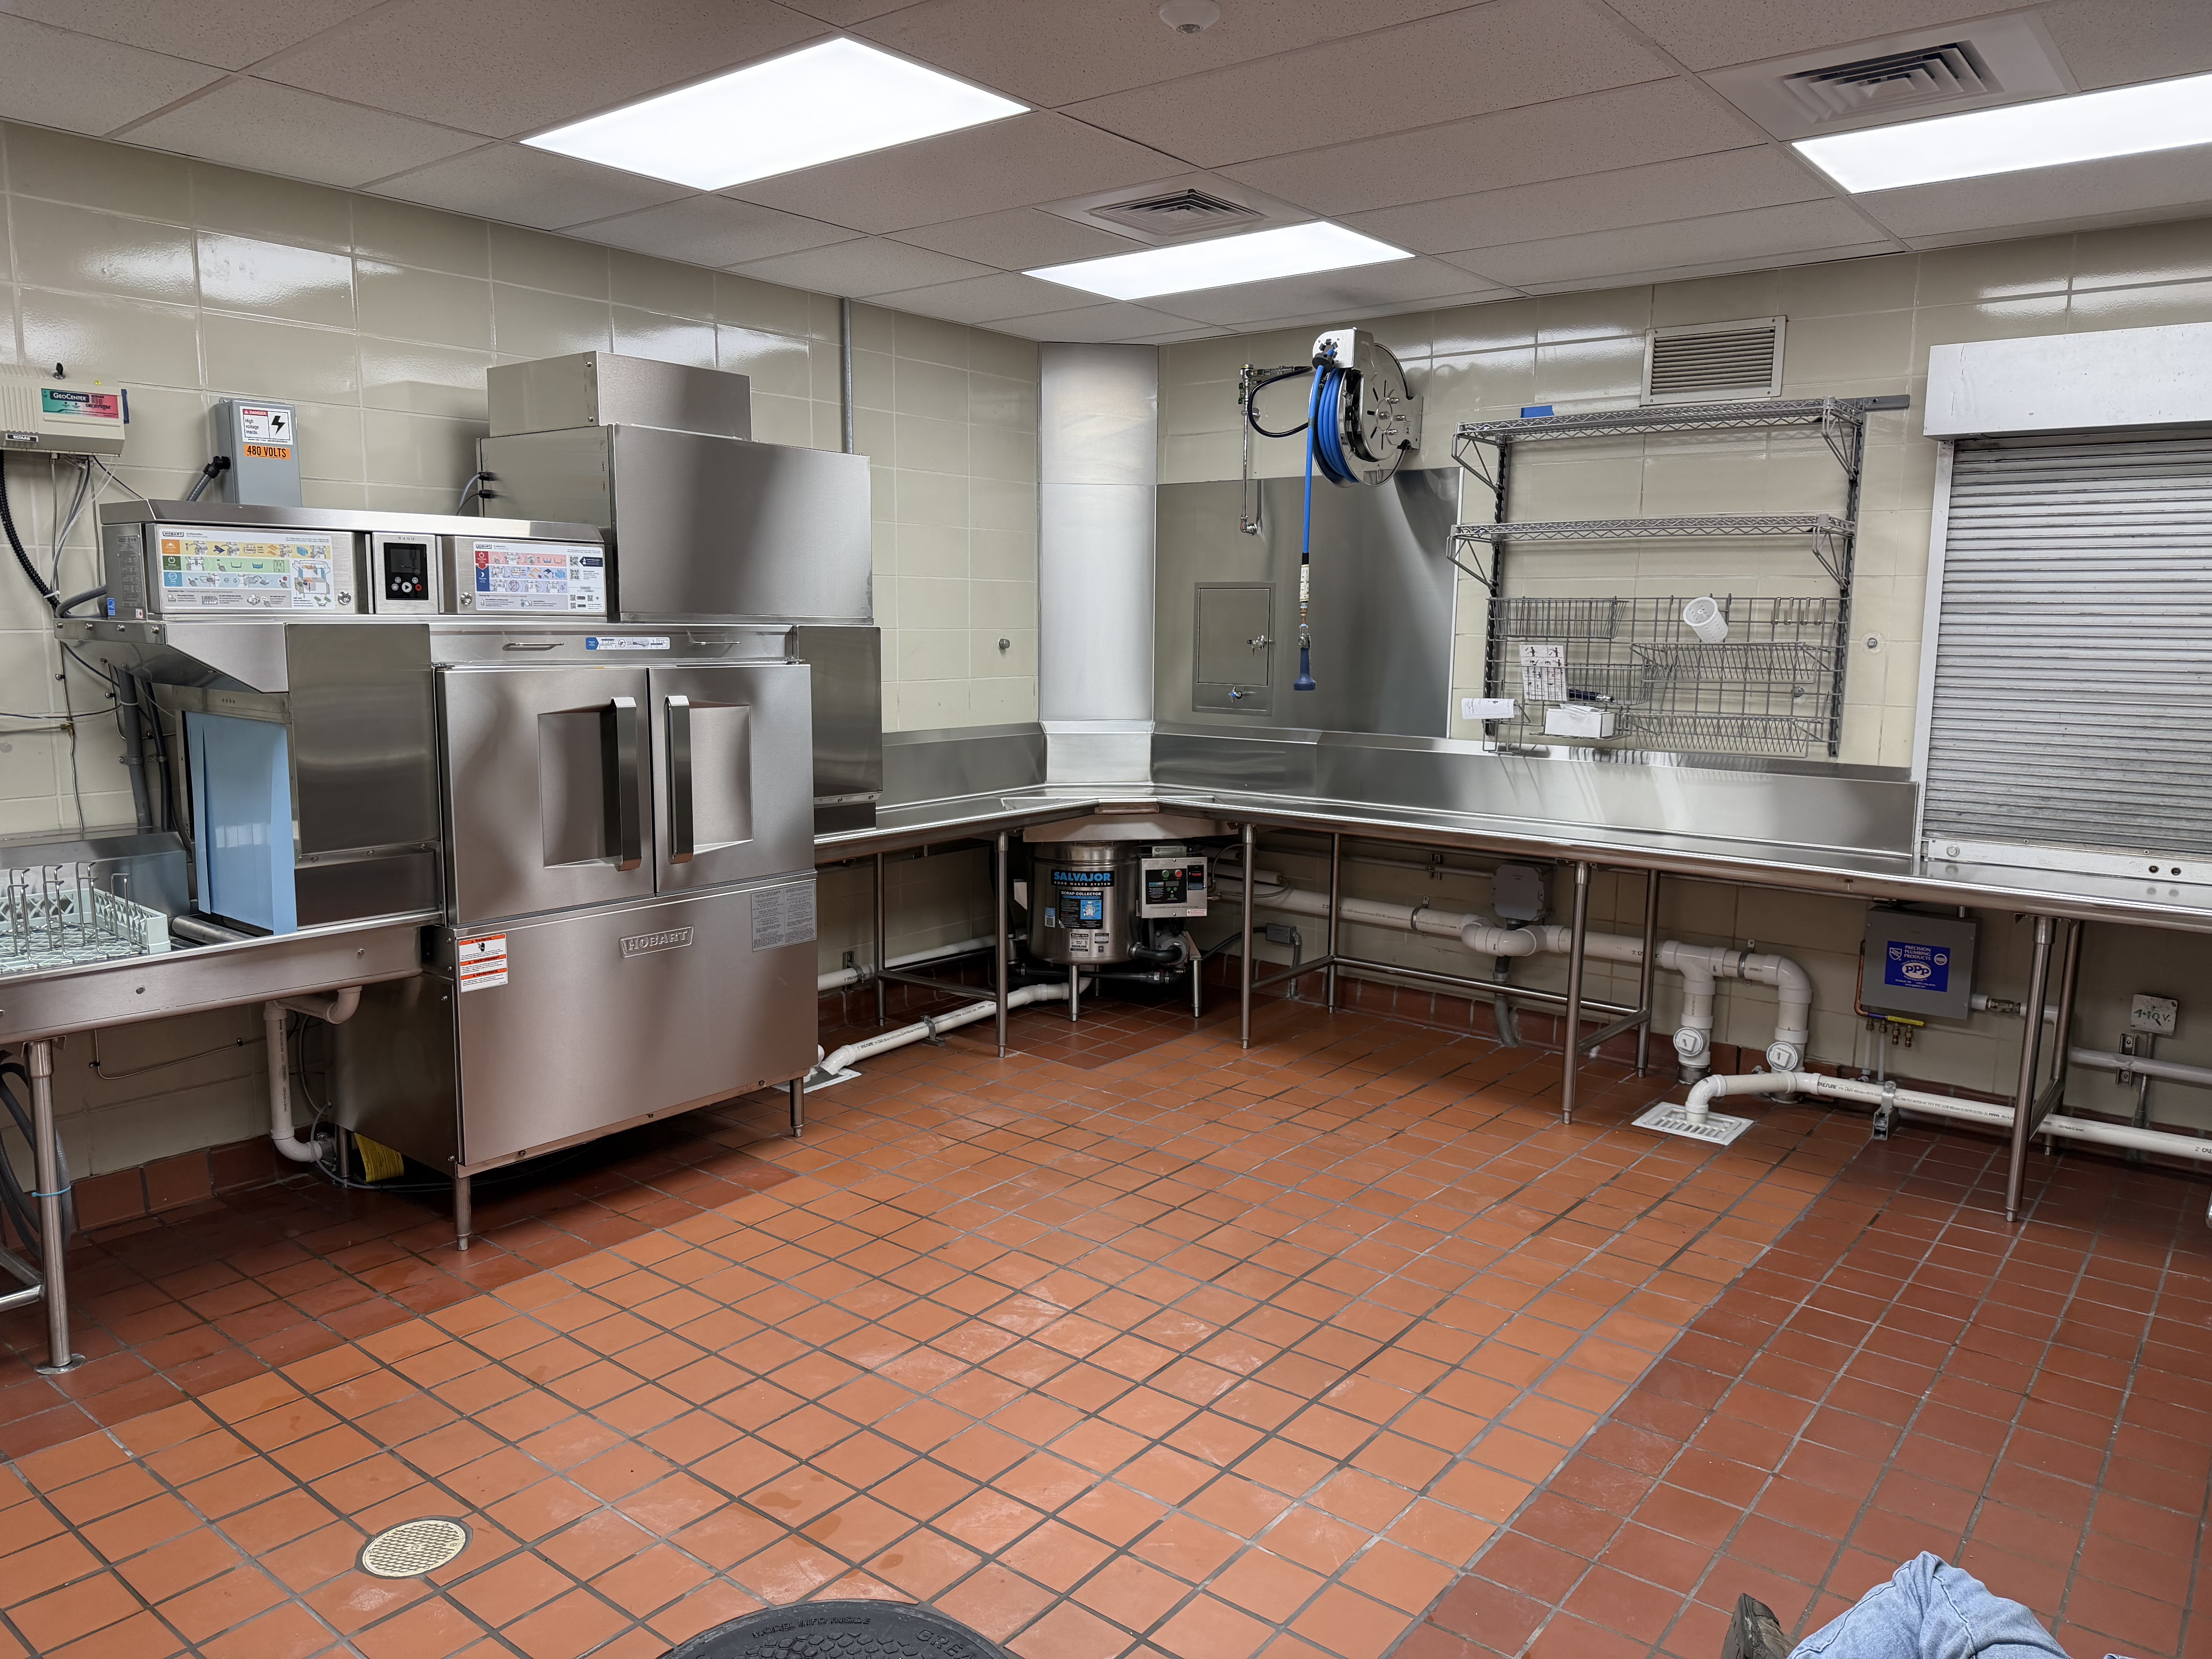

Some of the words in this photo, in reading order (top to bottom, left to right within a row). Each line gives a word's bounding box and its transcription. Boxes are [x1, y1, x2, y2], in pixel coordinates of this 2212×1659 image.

[247, 445, 261, 455] 480
[264, 447, 286, 457] VOLTS
[1054, 872, 1111, 881] SALVAJOR
[628, 930, 688, 950] HOBART
[752, 1622, 795, 1638] MODEL
[798, 1618, 828, 1627] INFO
[830, 1616, 871, 1625] INSIDE
